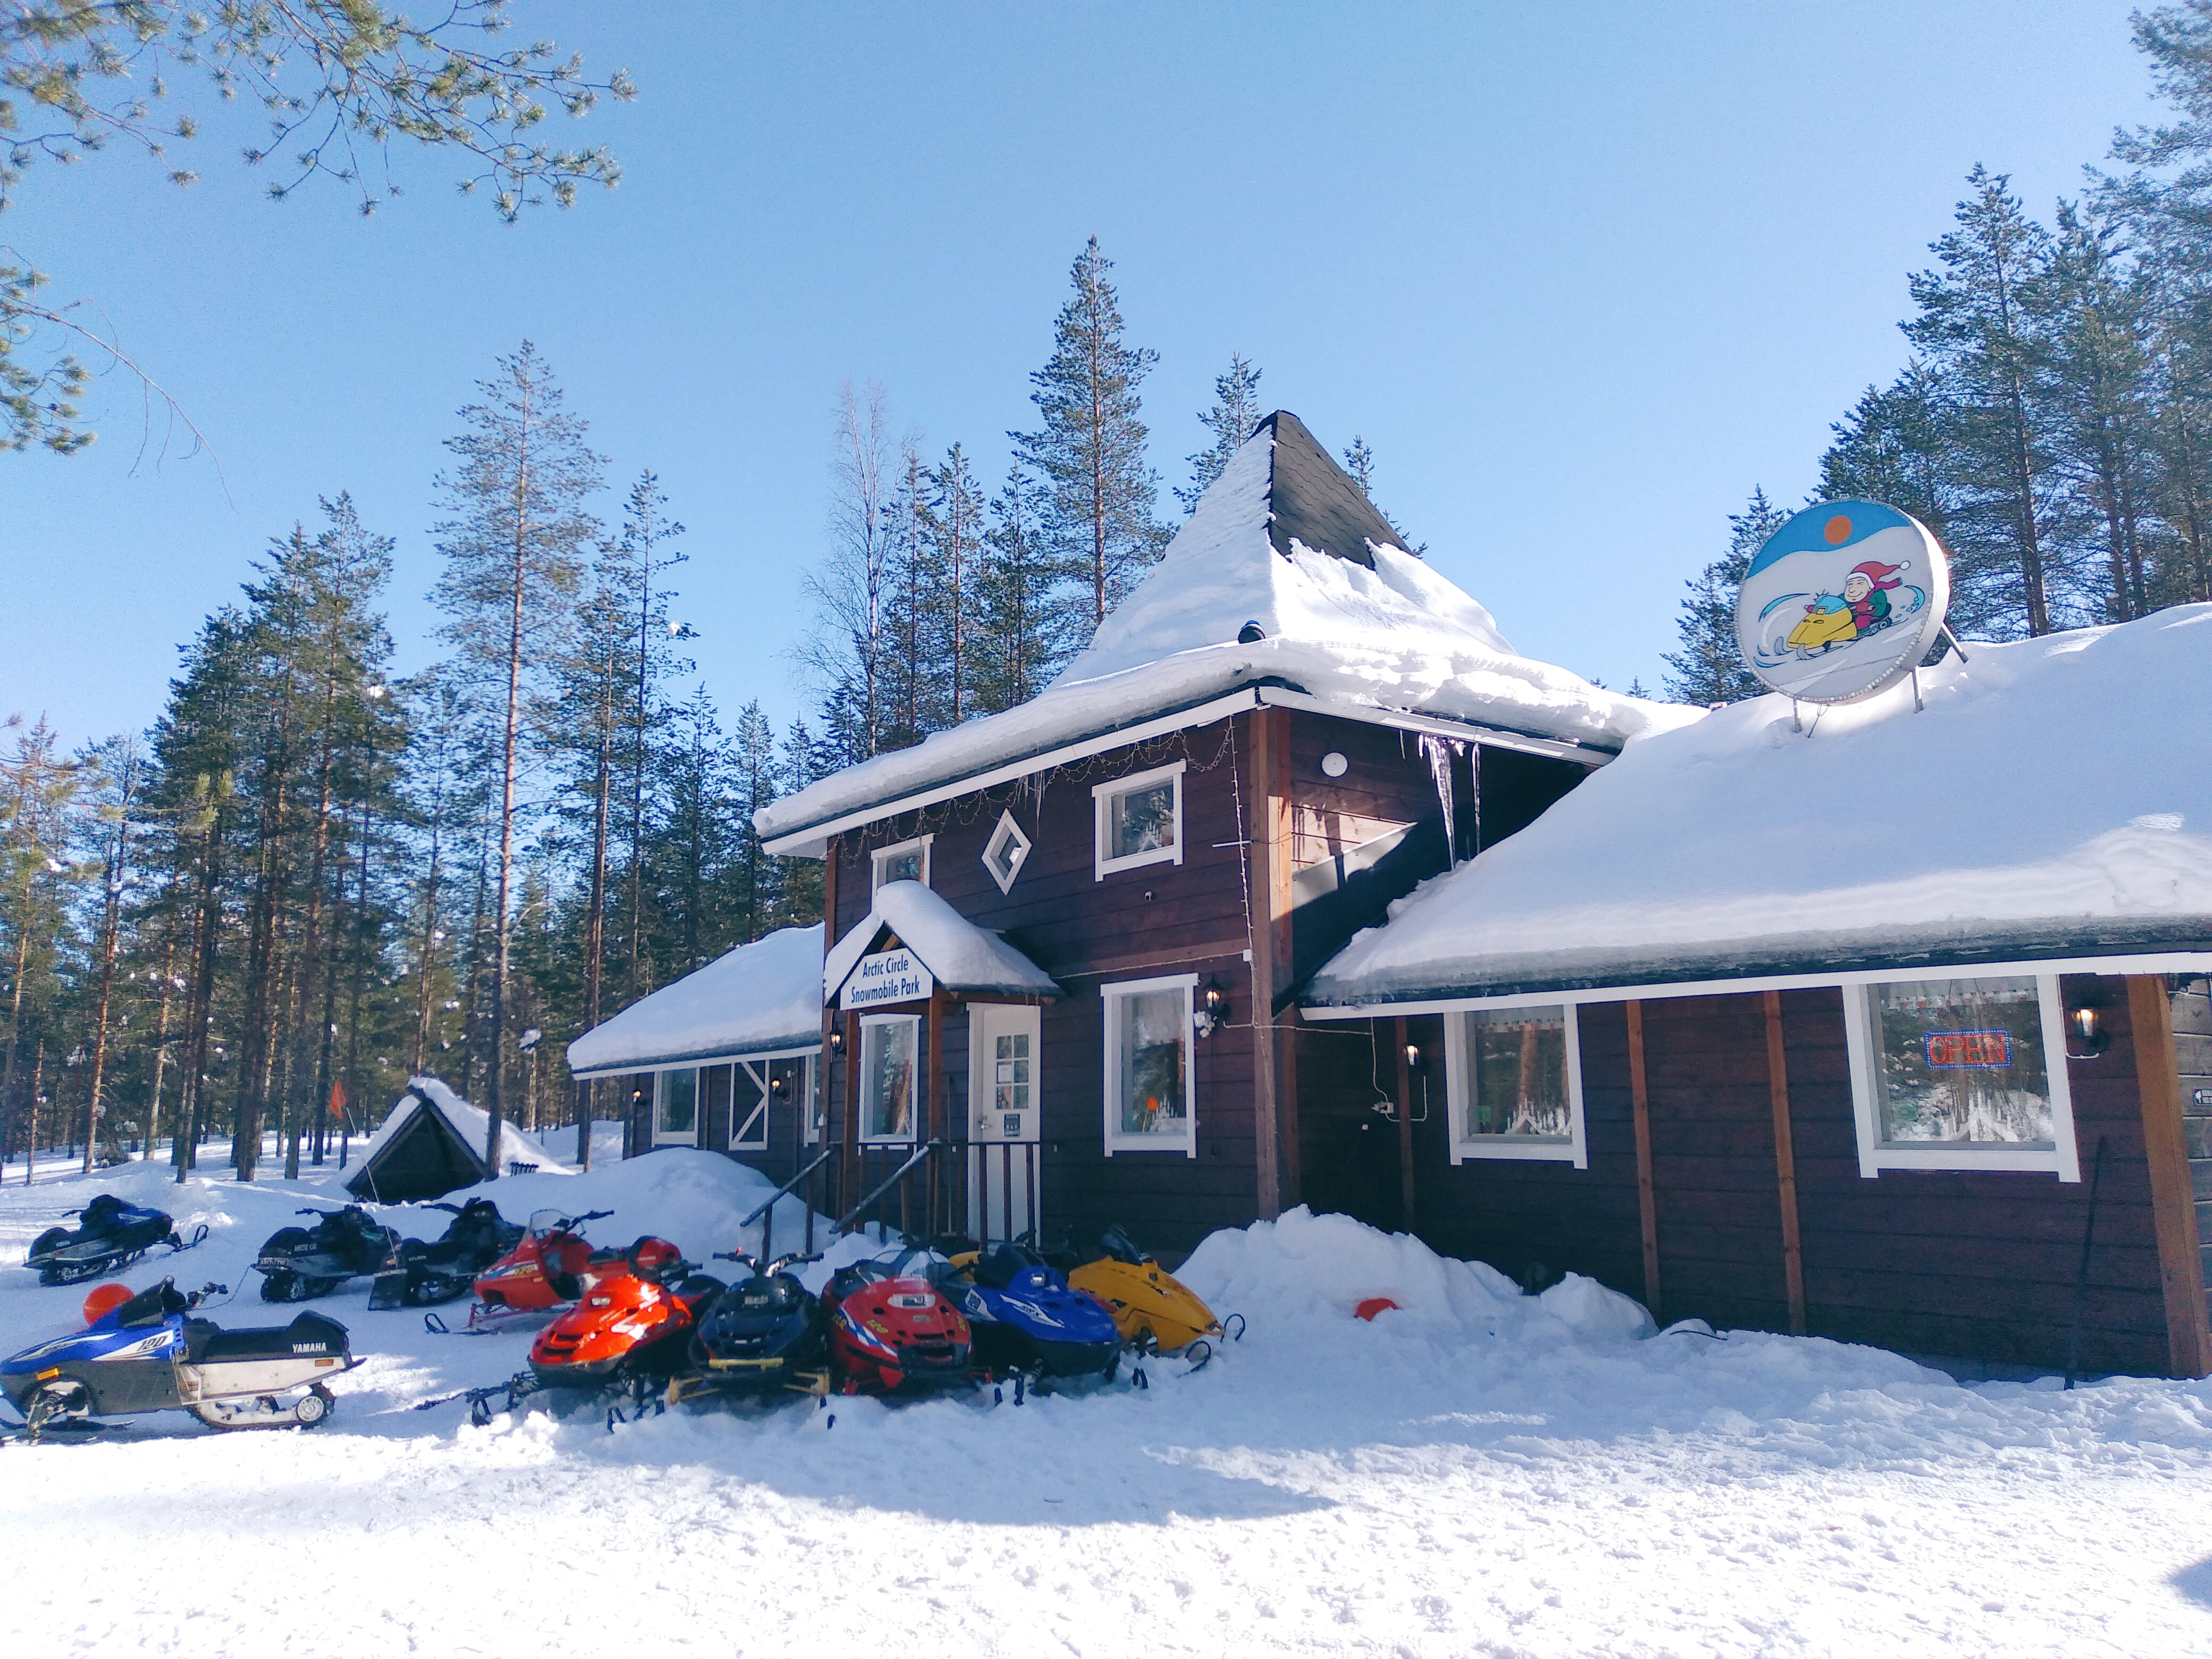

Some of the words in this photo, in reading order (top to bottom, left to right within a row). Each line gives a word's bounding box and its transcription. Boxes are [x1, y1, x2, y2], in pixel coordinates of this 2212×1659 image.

[862, 960, 884, 978] Arctic
[886, 953, 909, 974] Circle
[851, 978, 899, 1003] Snowmobile
[901, 974, 920, 996] Park
[1929, 1033, 2007, 1063] OPEN
[136, 1334, 169, 1352] 120
[292, 1342, 327, 1354] YAMAHA
